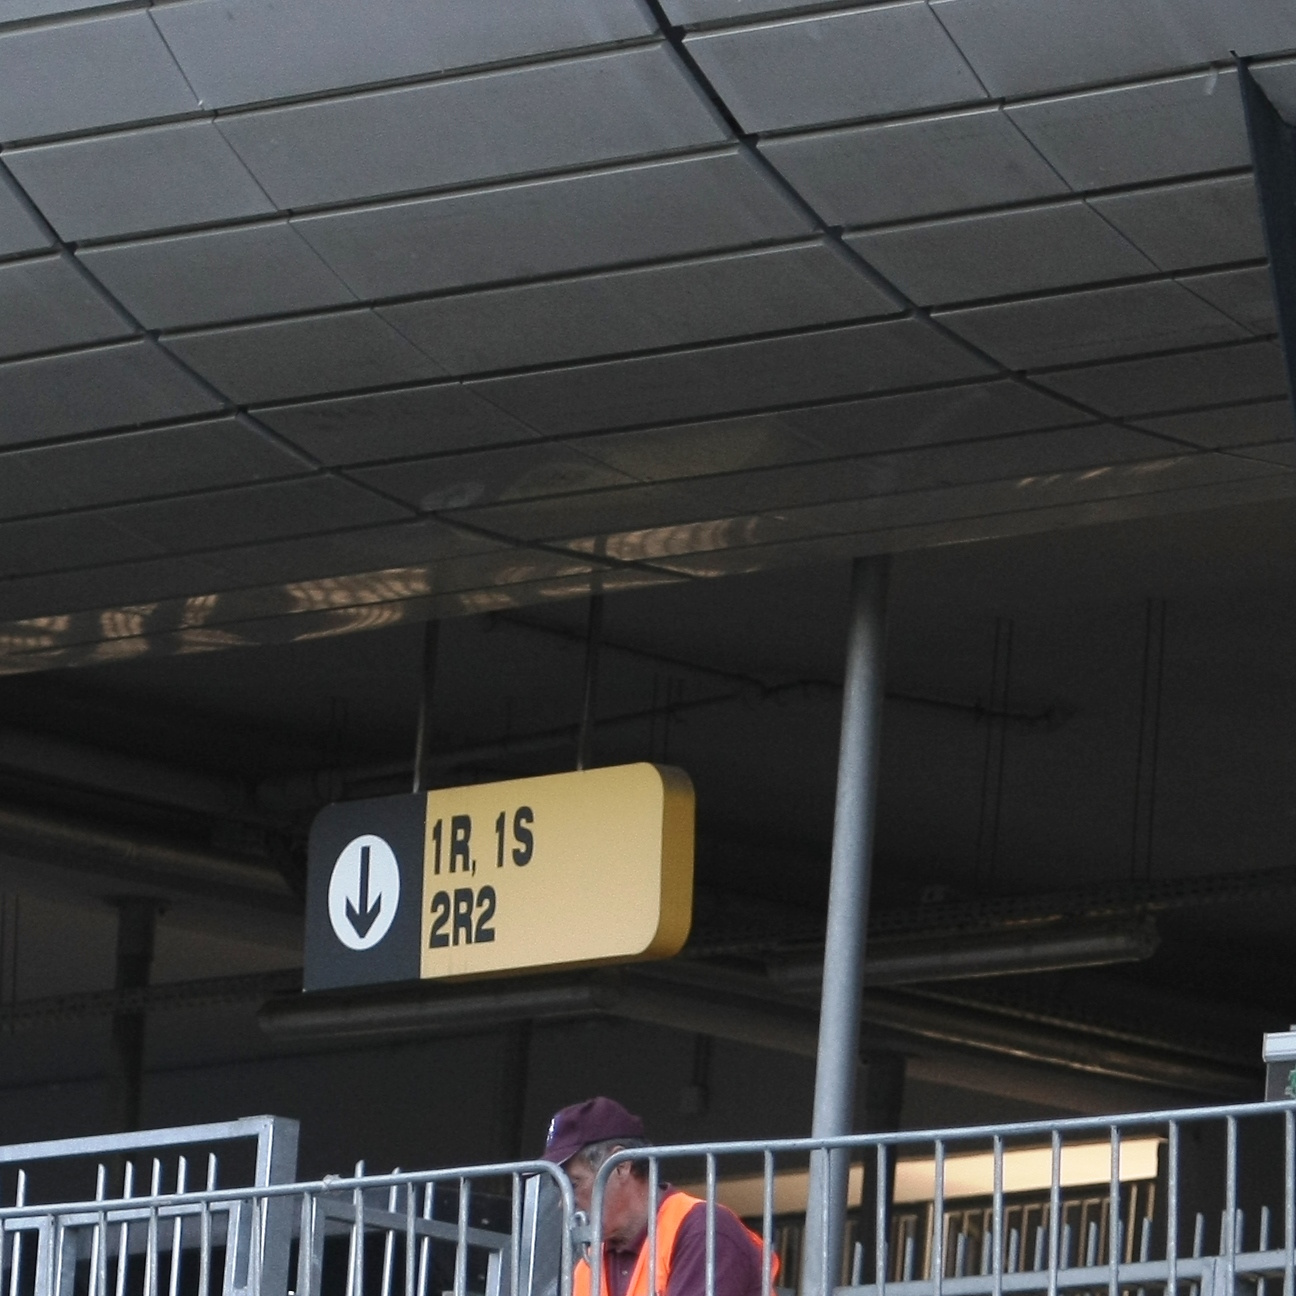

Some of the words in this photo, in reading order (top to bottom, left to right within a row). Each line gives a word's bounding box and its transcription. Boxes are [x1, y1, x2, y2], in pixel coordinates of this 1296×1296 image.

[432, 814, 477, 877] 1R,
[495, 805, 535, 868] 1S
[428, 885, 497, 949] 2R2
